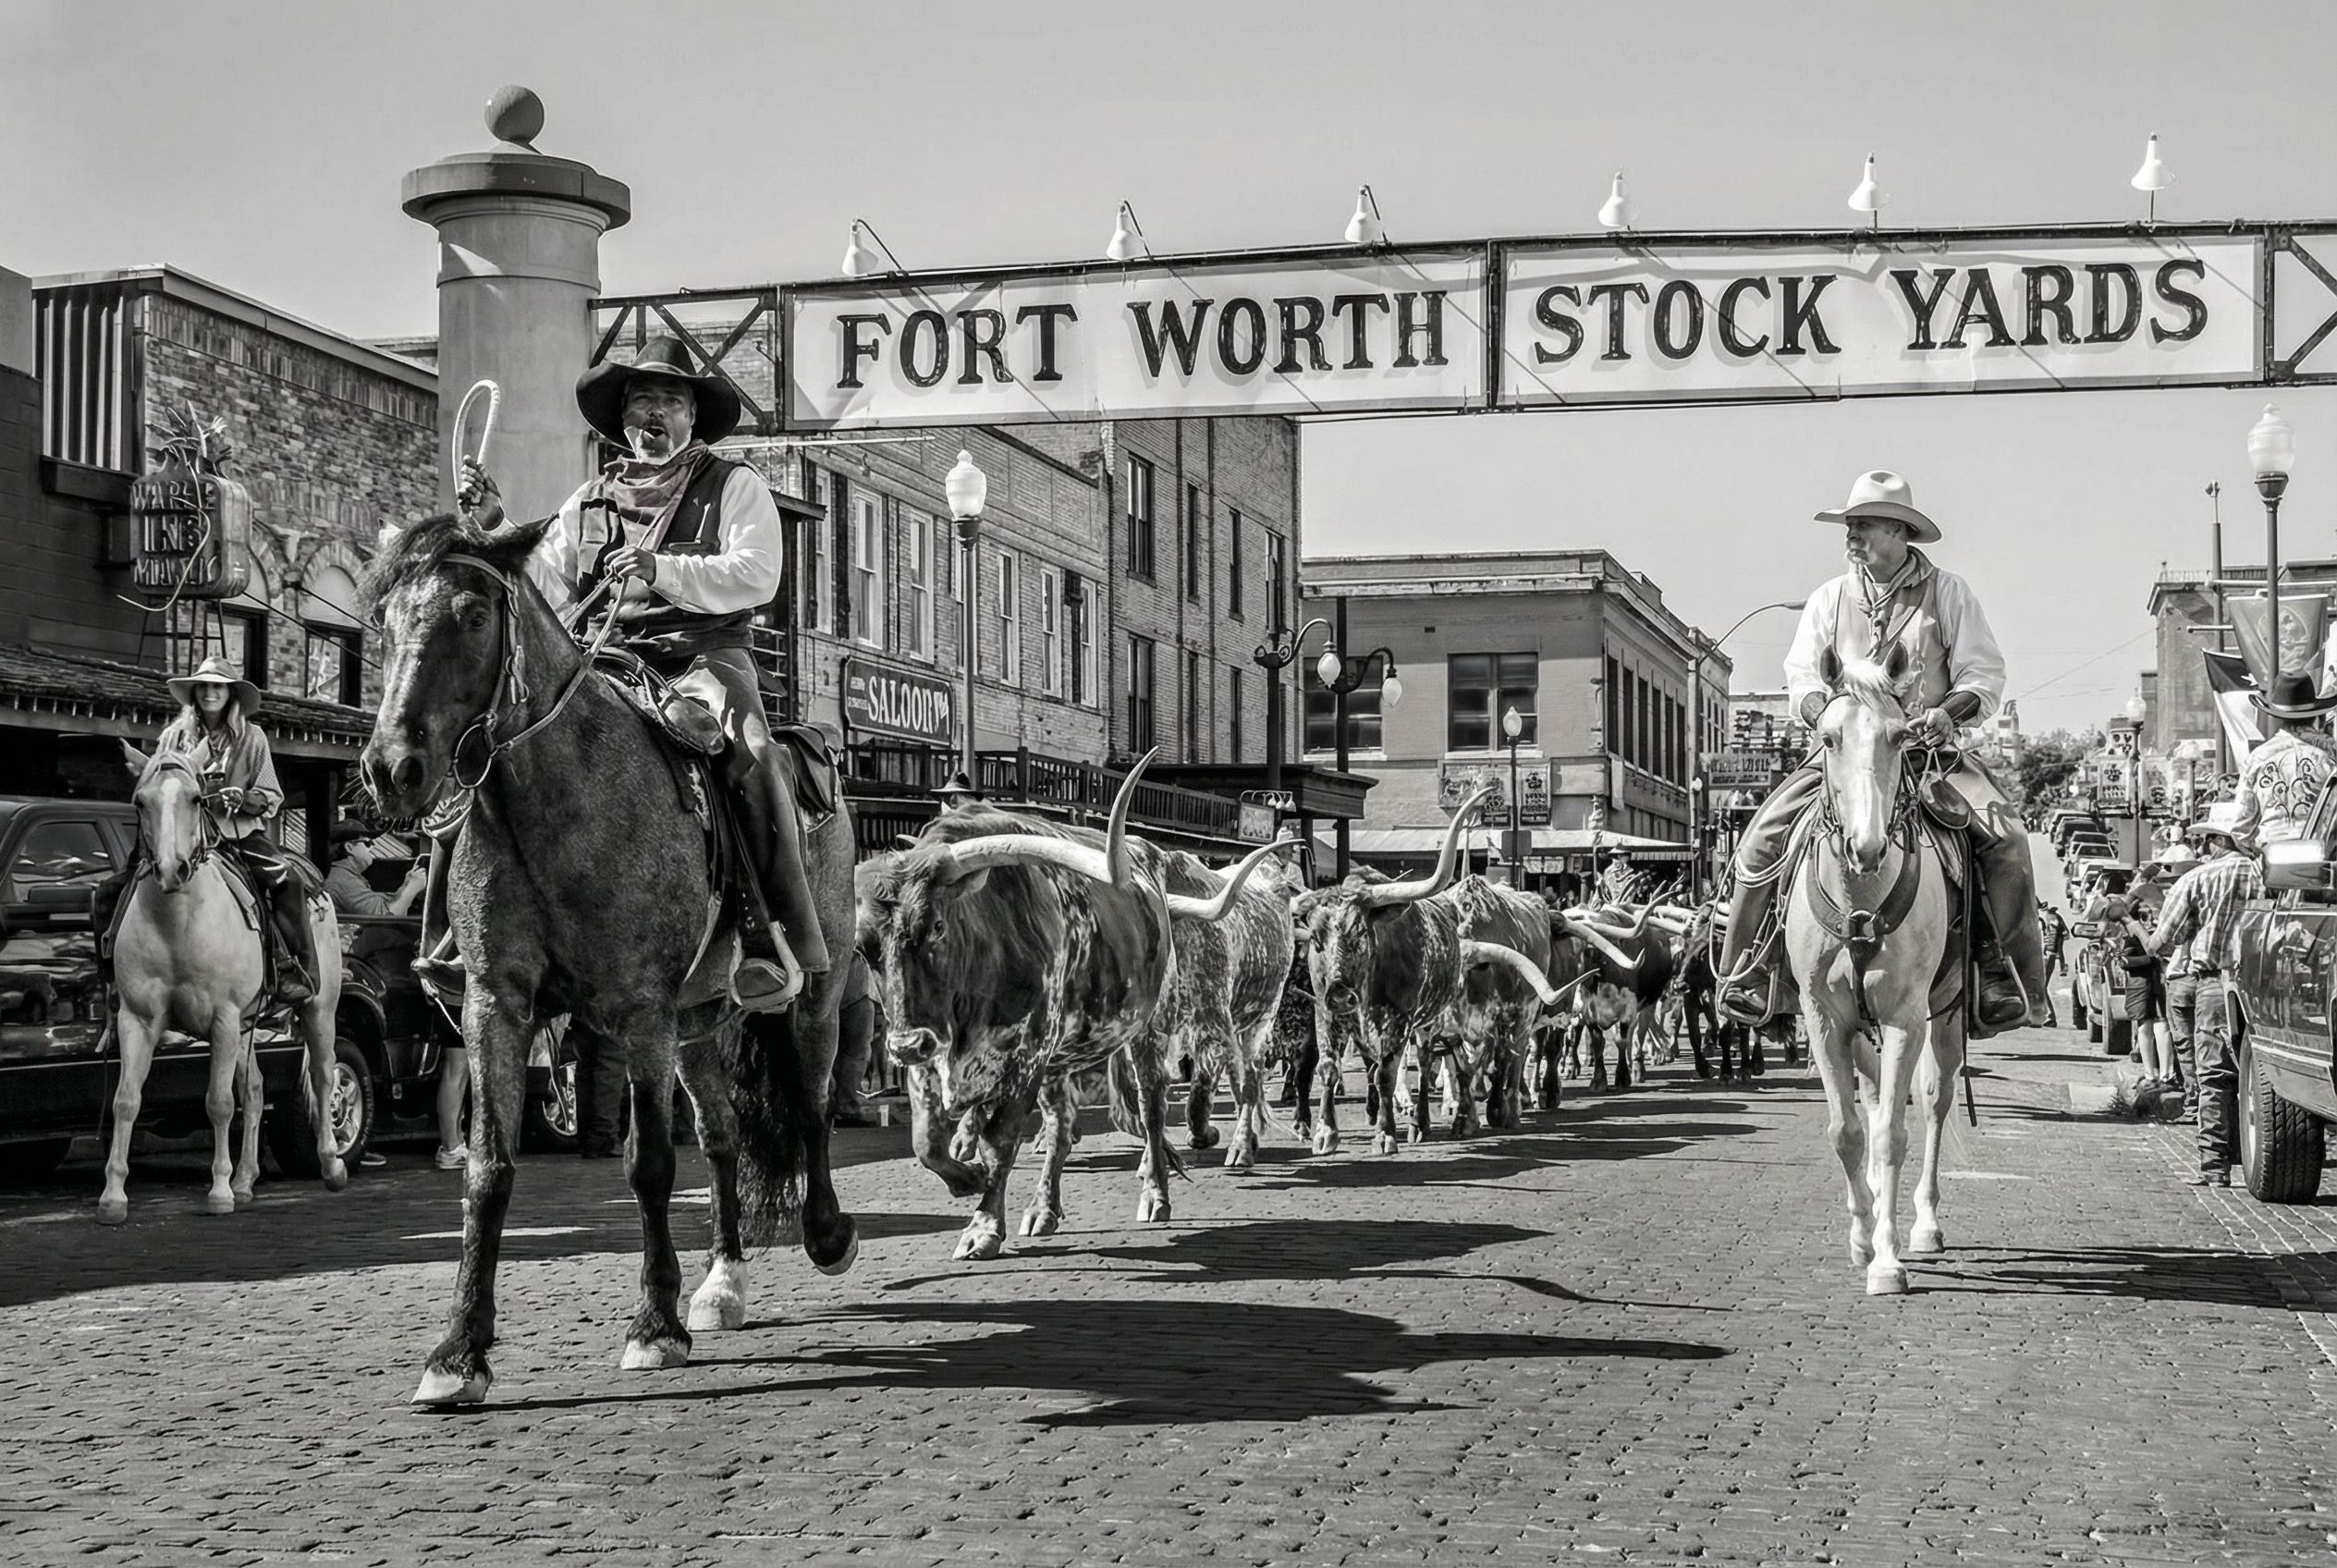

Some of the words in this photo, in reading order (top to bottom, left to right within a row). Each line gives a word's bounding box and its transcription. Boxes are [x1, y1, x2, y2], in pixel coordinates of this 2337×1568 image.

[837, 303, 1079, 388] FORT
[1127, 289, 1449, 378] WORTH
[1534, 275, 1841, 363] STOCK
[1890, 259, 2207, 350] YARDS
